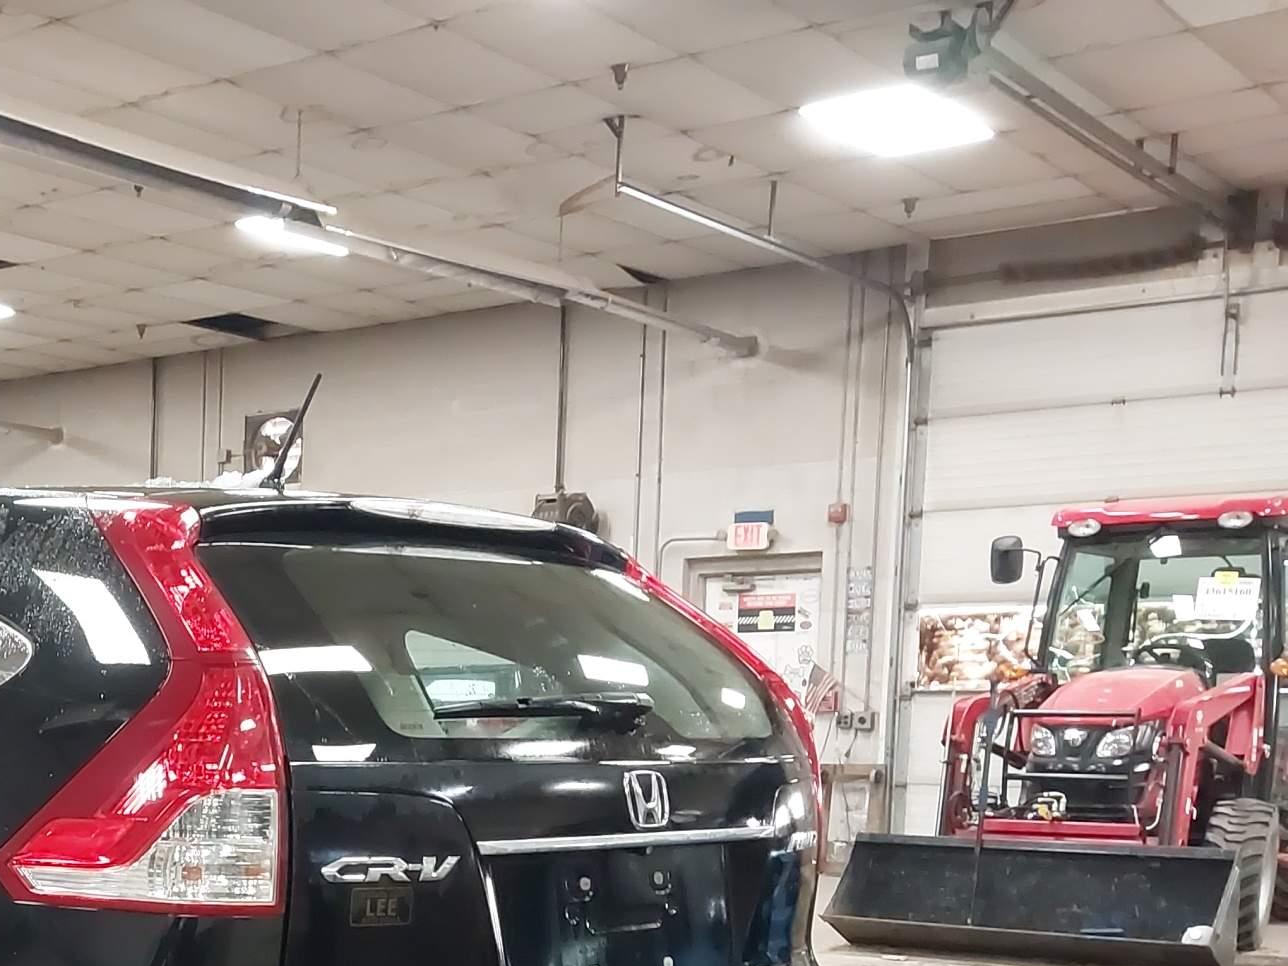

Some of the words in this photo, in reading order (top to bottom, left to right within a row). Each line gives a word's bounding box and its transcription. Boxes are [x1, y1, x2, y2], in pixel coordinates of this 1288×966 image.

[734, 524, 762, 547] EXIT
[320, 855, 461, 883] CR-V
[365, 898, 398, 917] LEE
